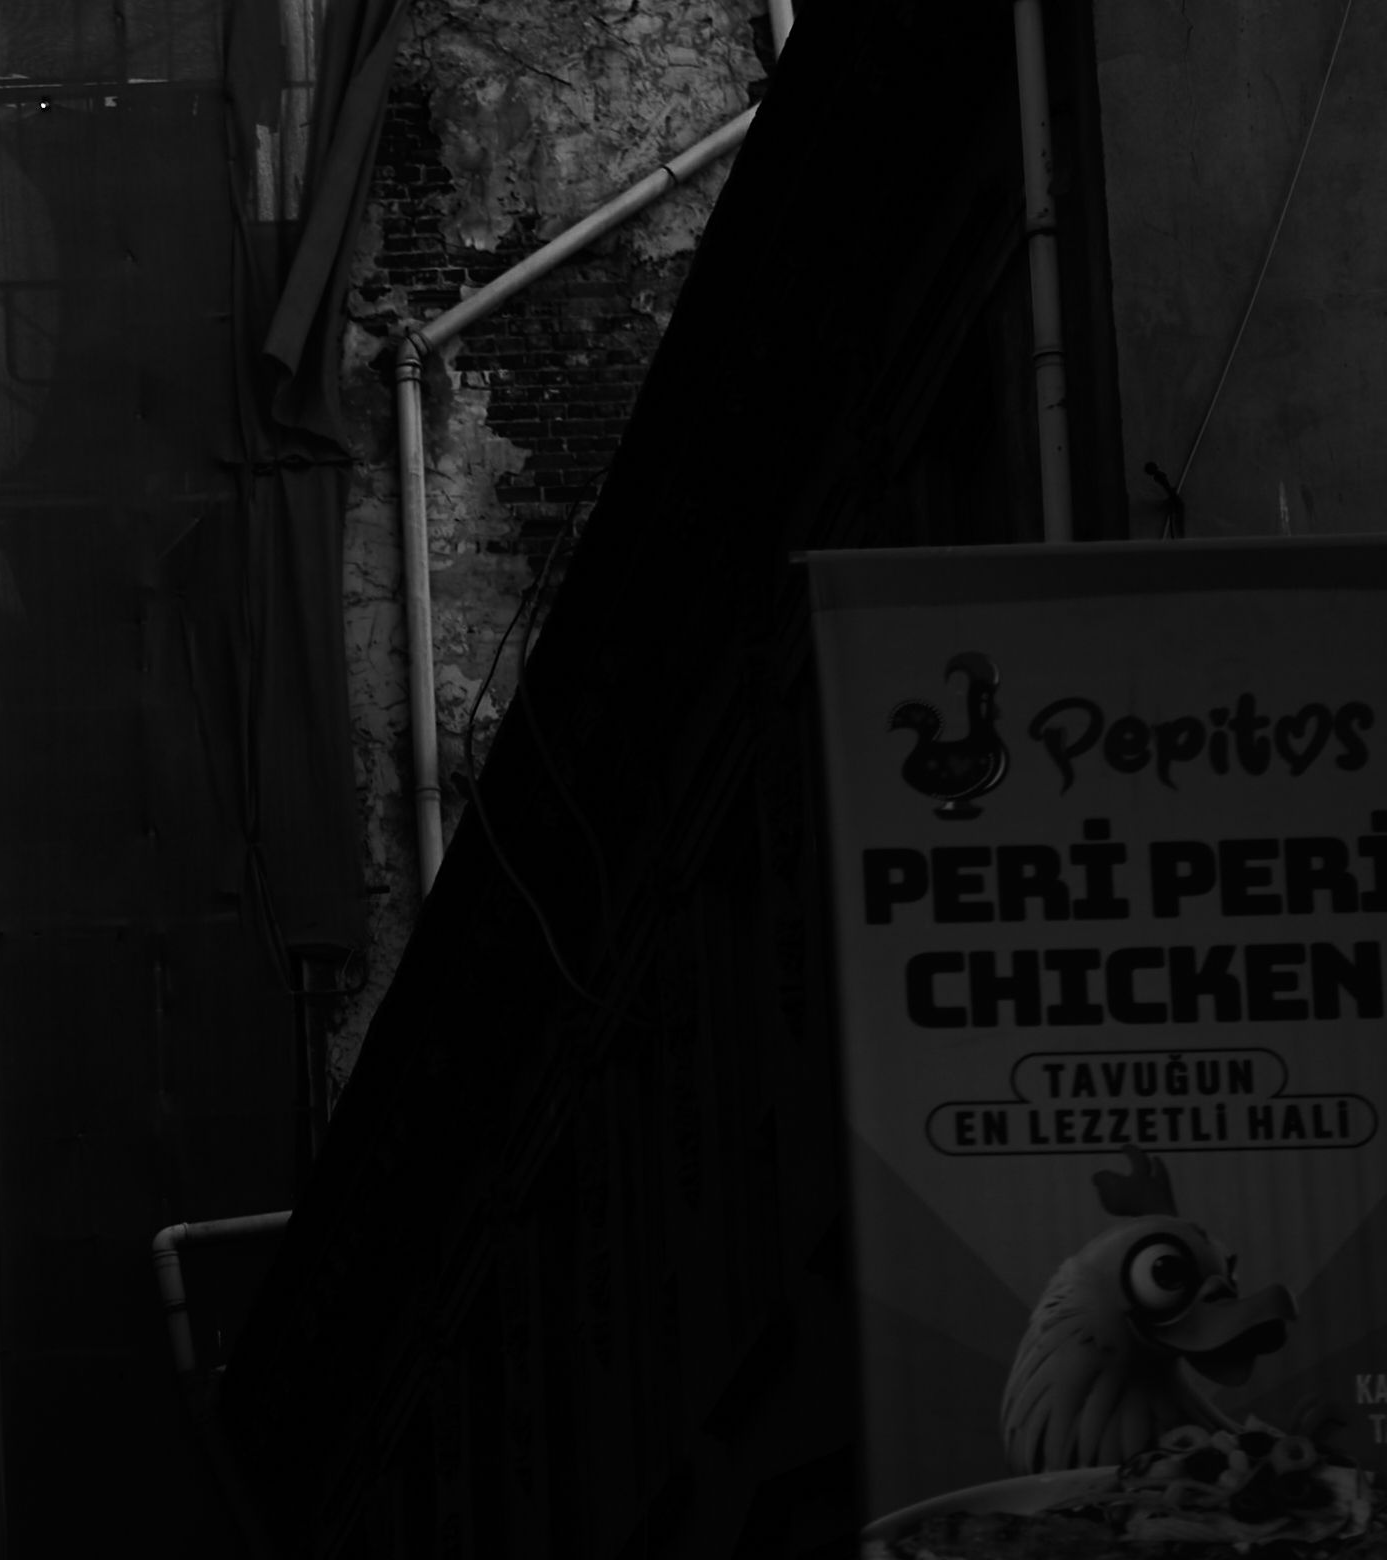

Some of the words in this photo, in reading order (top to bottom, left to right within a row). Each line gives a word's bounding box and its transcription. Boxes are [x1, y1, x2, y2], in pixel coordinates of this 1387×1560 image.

[1027, 690, 1375, 796] Pepitos
[862, 817, 1130, 925] PERİ
[904, 941, 1384, 1029] CHICKEN
[1043, 1053, 1254, 1099] TAVUĞUN
[954, 1109, 1009, 1146] EN
[1028, 1103, 1227, 1145] LEZZETLİ
[1247, 1099, 1350, 1141] HALİ
[1367, 1413, 1387, 1444] T
